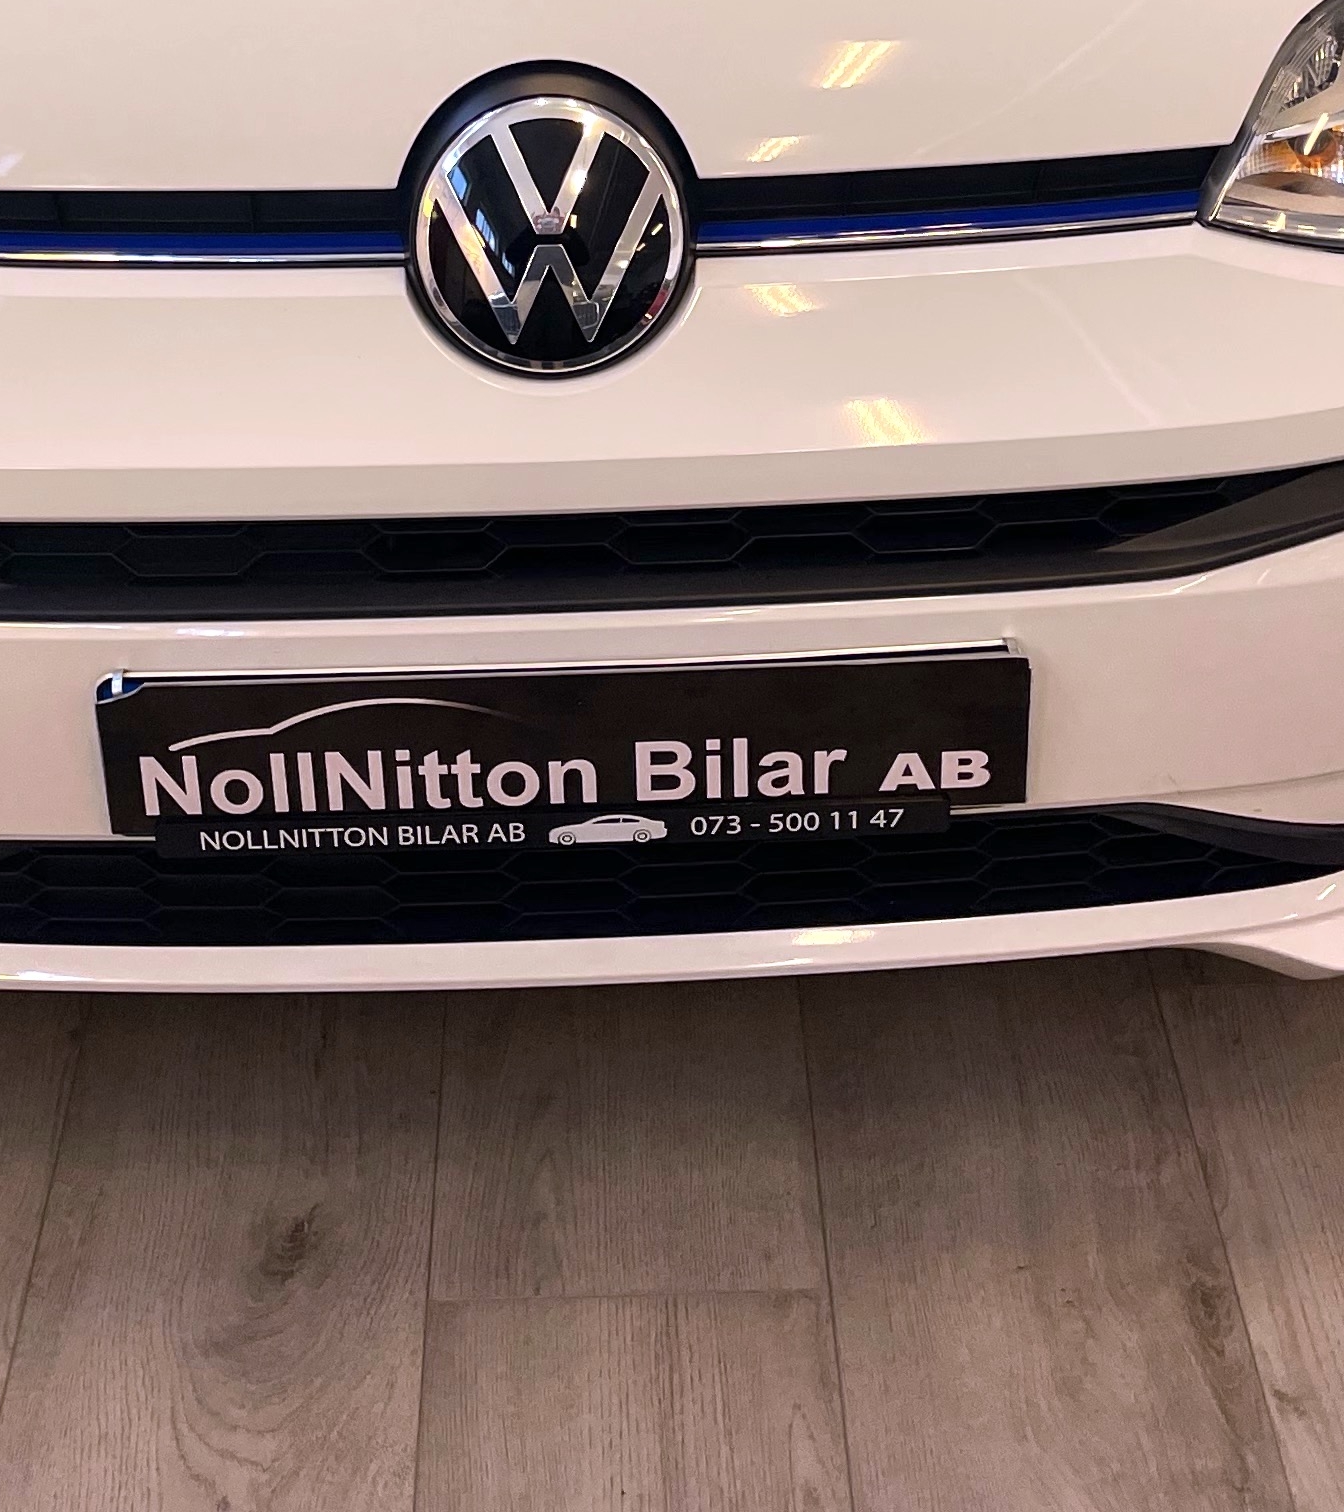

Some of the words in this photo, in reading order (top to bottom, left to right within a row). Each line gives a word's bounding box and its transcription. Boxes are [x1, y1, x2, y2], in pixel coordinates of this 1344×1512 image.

[138, 748, 598, 817] NollNitton
[634, 737, 848, 802] Bilar
[878, 749, 992, 792] AB
[199, 825, 390, 852] NOLLNITTON
[397, 823, 480, 847] BILAR
[486, 822, 526, 844] AB
[690, 814, 743, 837] 073
[768, 811, 821, 834] 500
[829, 808, 859, 831] 11
[869, 807, 906, 830] 47
